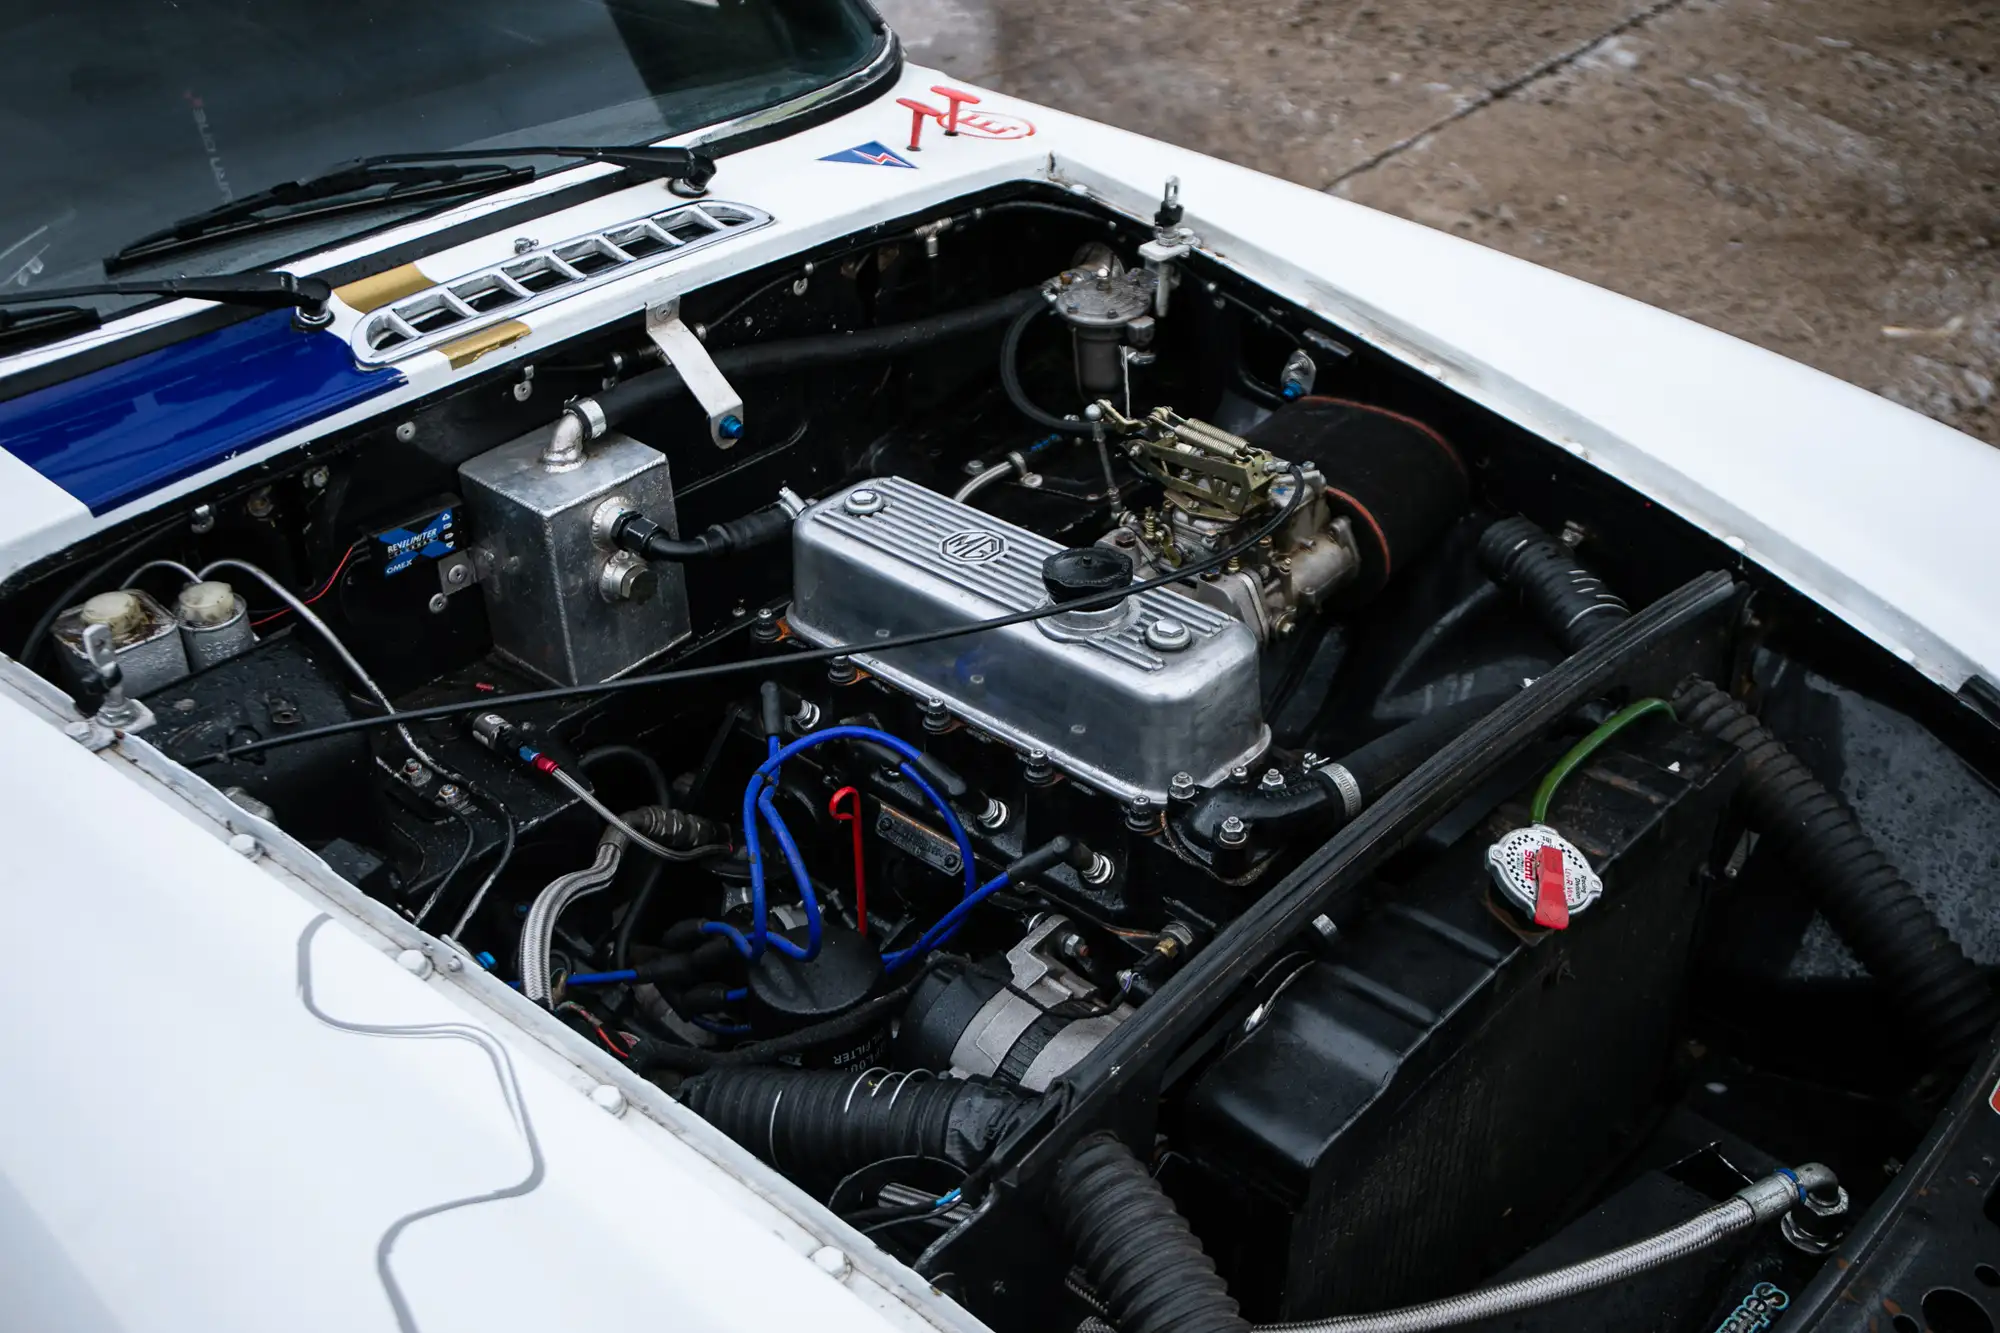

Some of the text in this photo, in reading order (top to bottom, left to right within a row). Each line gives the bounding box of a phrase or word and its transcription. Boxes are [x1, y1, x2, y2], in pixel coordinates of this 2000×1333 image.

[946, 533, 998, 560] MG
[386, 559, 412, 574] OMEX
[1524, 849, 1536, 881] Stant
[833, 1041, 871, 1065] FILTER
